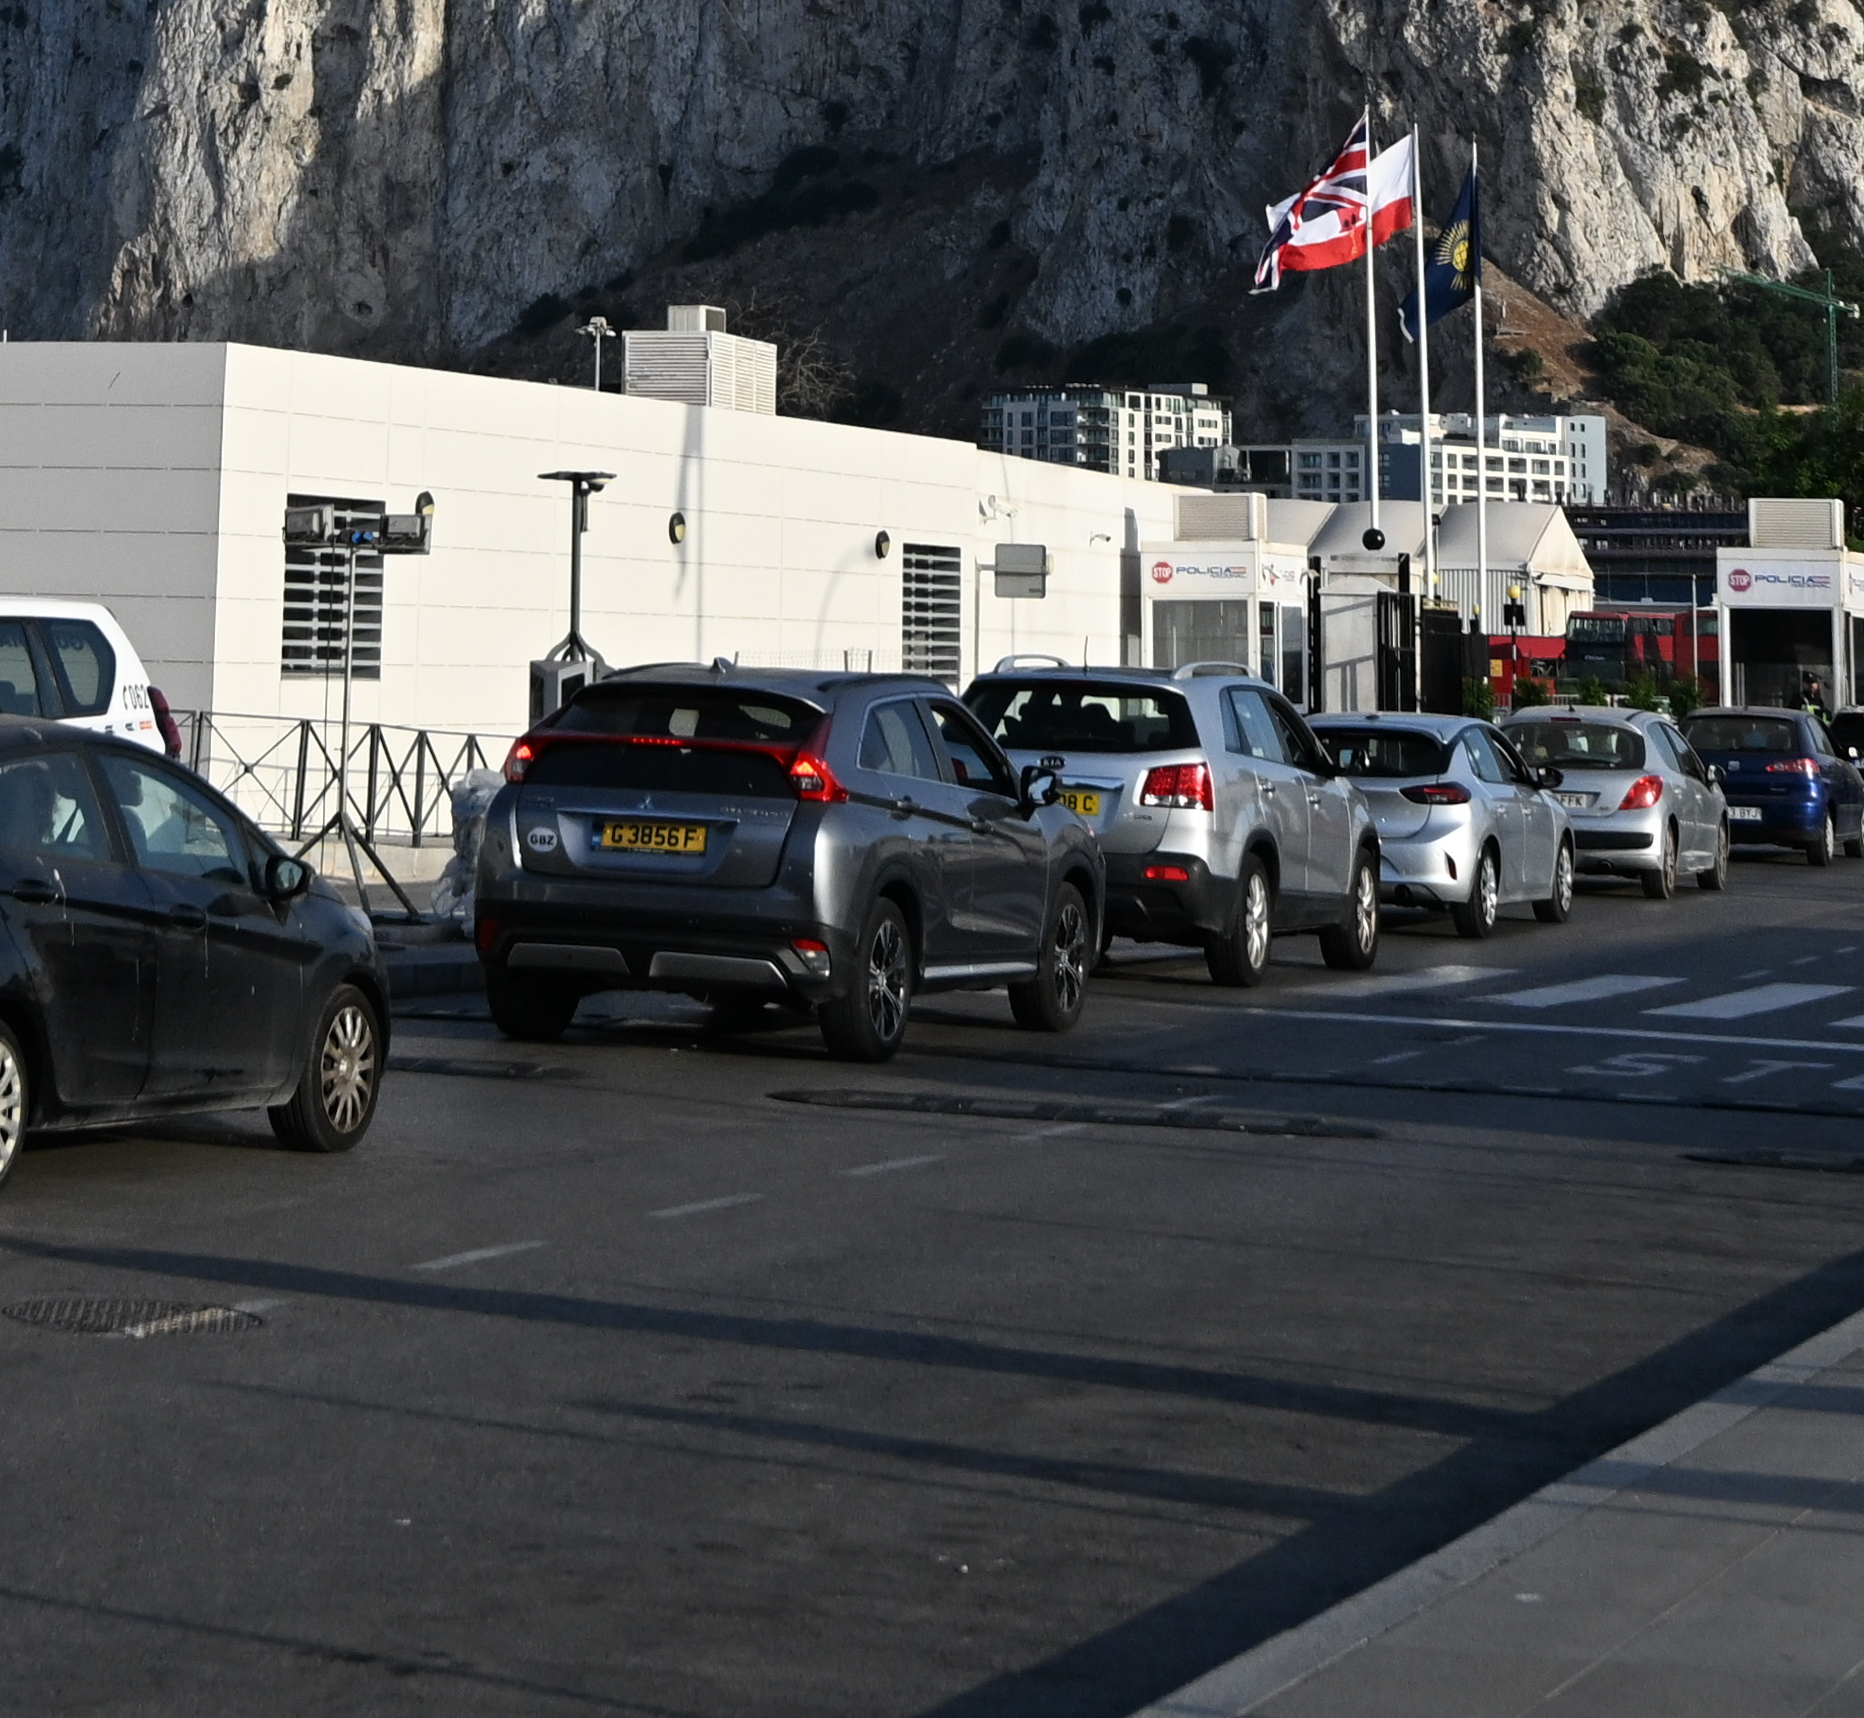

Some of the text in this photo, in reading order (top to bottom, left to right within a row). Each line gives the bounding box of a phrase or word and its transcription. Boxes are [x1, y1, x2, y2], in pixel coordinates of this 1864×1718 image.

[1153, 567, 1172, 578] STOP
[1176, 566, 1232, 575] POLICIA
[1729, 574, 1751, 586] STOP
[1754, 574, 1815, 583] POLICIA
[130, 684, 150, 710] 062
[1082, 794, 1093, 812] C
[530, 834, 555, 846] GBZ
[611, 824, 698, 849] G 3856 F
